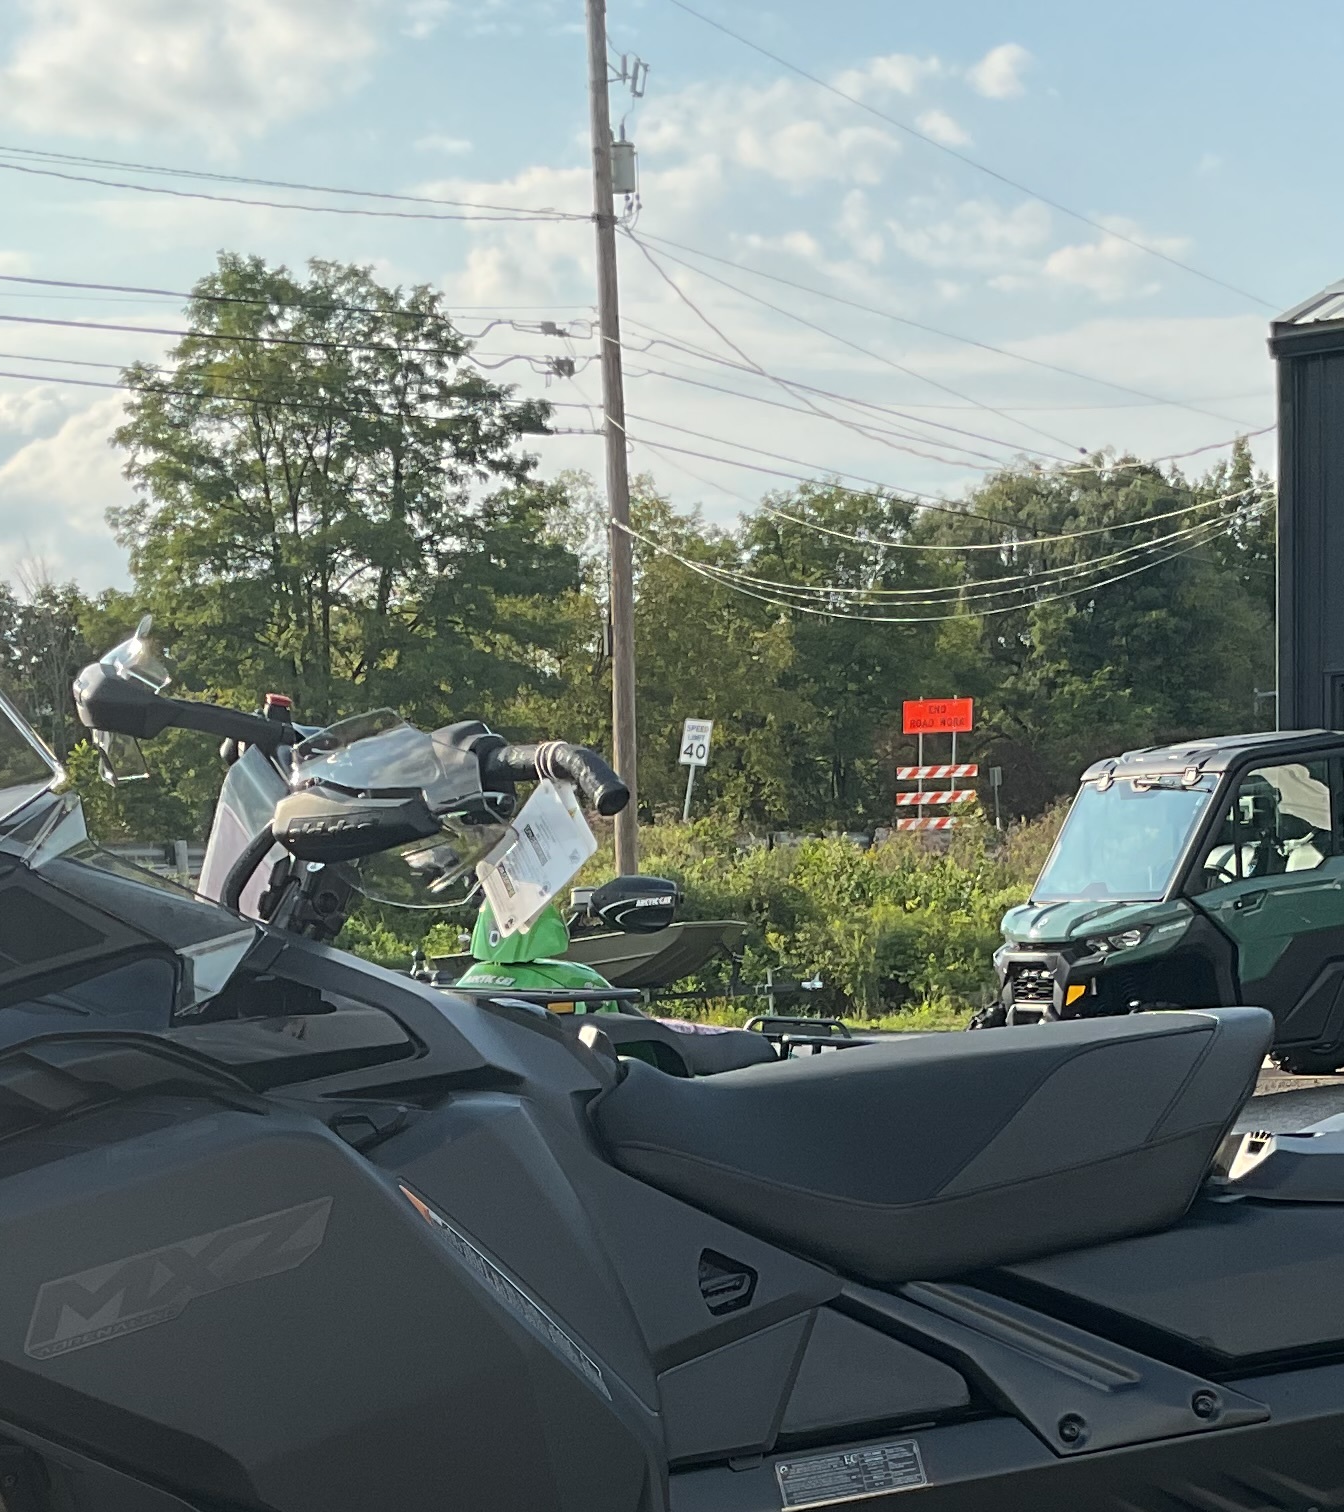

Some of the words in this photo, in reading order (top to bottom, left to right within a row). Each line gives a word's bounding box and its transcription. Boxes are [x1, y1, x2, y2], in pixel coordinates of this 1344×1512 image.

[928, 704, 947, 714] END
[909, 719, 935, 729] ROAD
[940, 717, 966, 728] WORK
[687, 724, 710, 733] SPEED
[683, 742, 707, 760] 40
[635, 898, 659, 907] ARCTIC
